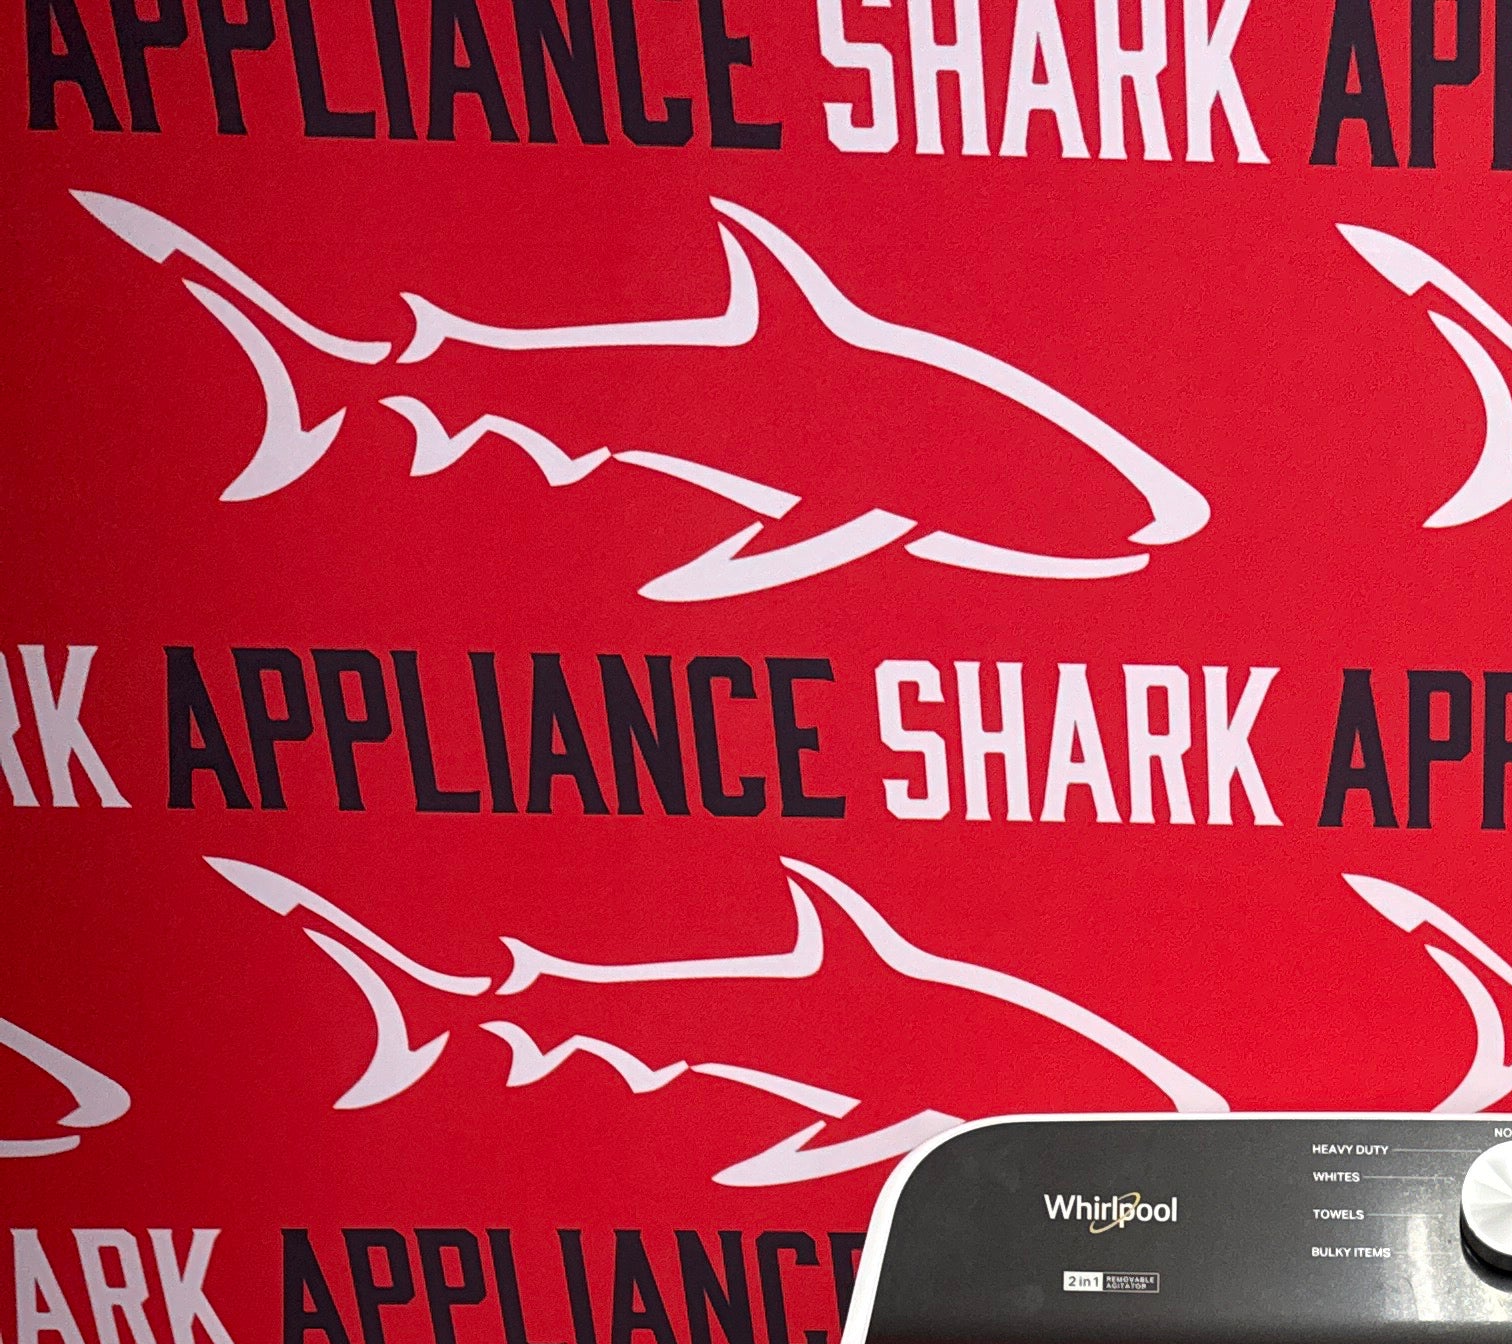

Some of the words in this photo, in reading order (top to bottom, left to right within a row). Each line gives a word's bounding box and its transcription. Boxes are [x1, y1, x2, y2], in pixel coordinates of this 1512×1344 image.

[26, 0, 783, 149] APPLIANCE
[817, 0, 1271, 164] SHARK
[163, 646, 846, 818] APPLIANCE
[874, 660, 1284, 827] SHARK
[1312, 1143, 1353, 1155] HEAVY
[1356, 1144, 1389, 1156] DUTY
[1313, 1171, 1360, 1183] WHITES
[1043, 1193, 1178, 1229] Whirlpool
[1313, 1208, 1365, 1220] TOWELS
[1312, 1247, 1351, 1258] BULKY
[1354, 1247, 1391, 1259] ITEMS
[1068, 1276, 1076, 1287] 2
[1079, 1276, 1091, 1287] in
[1094, 1276, 1099, 1287] 1
[1105, 1275, 1155, 1284] REMOVABLE
